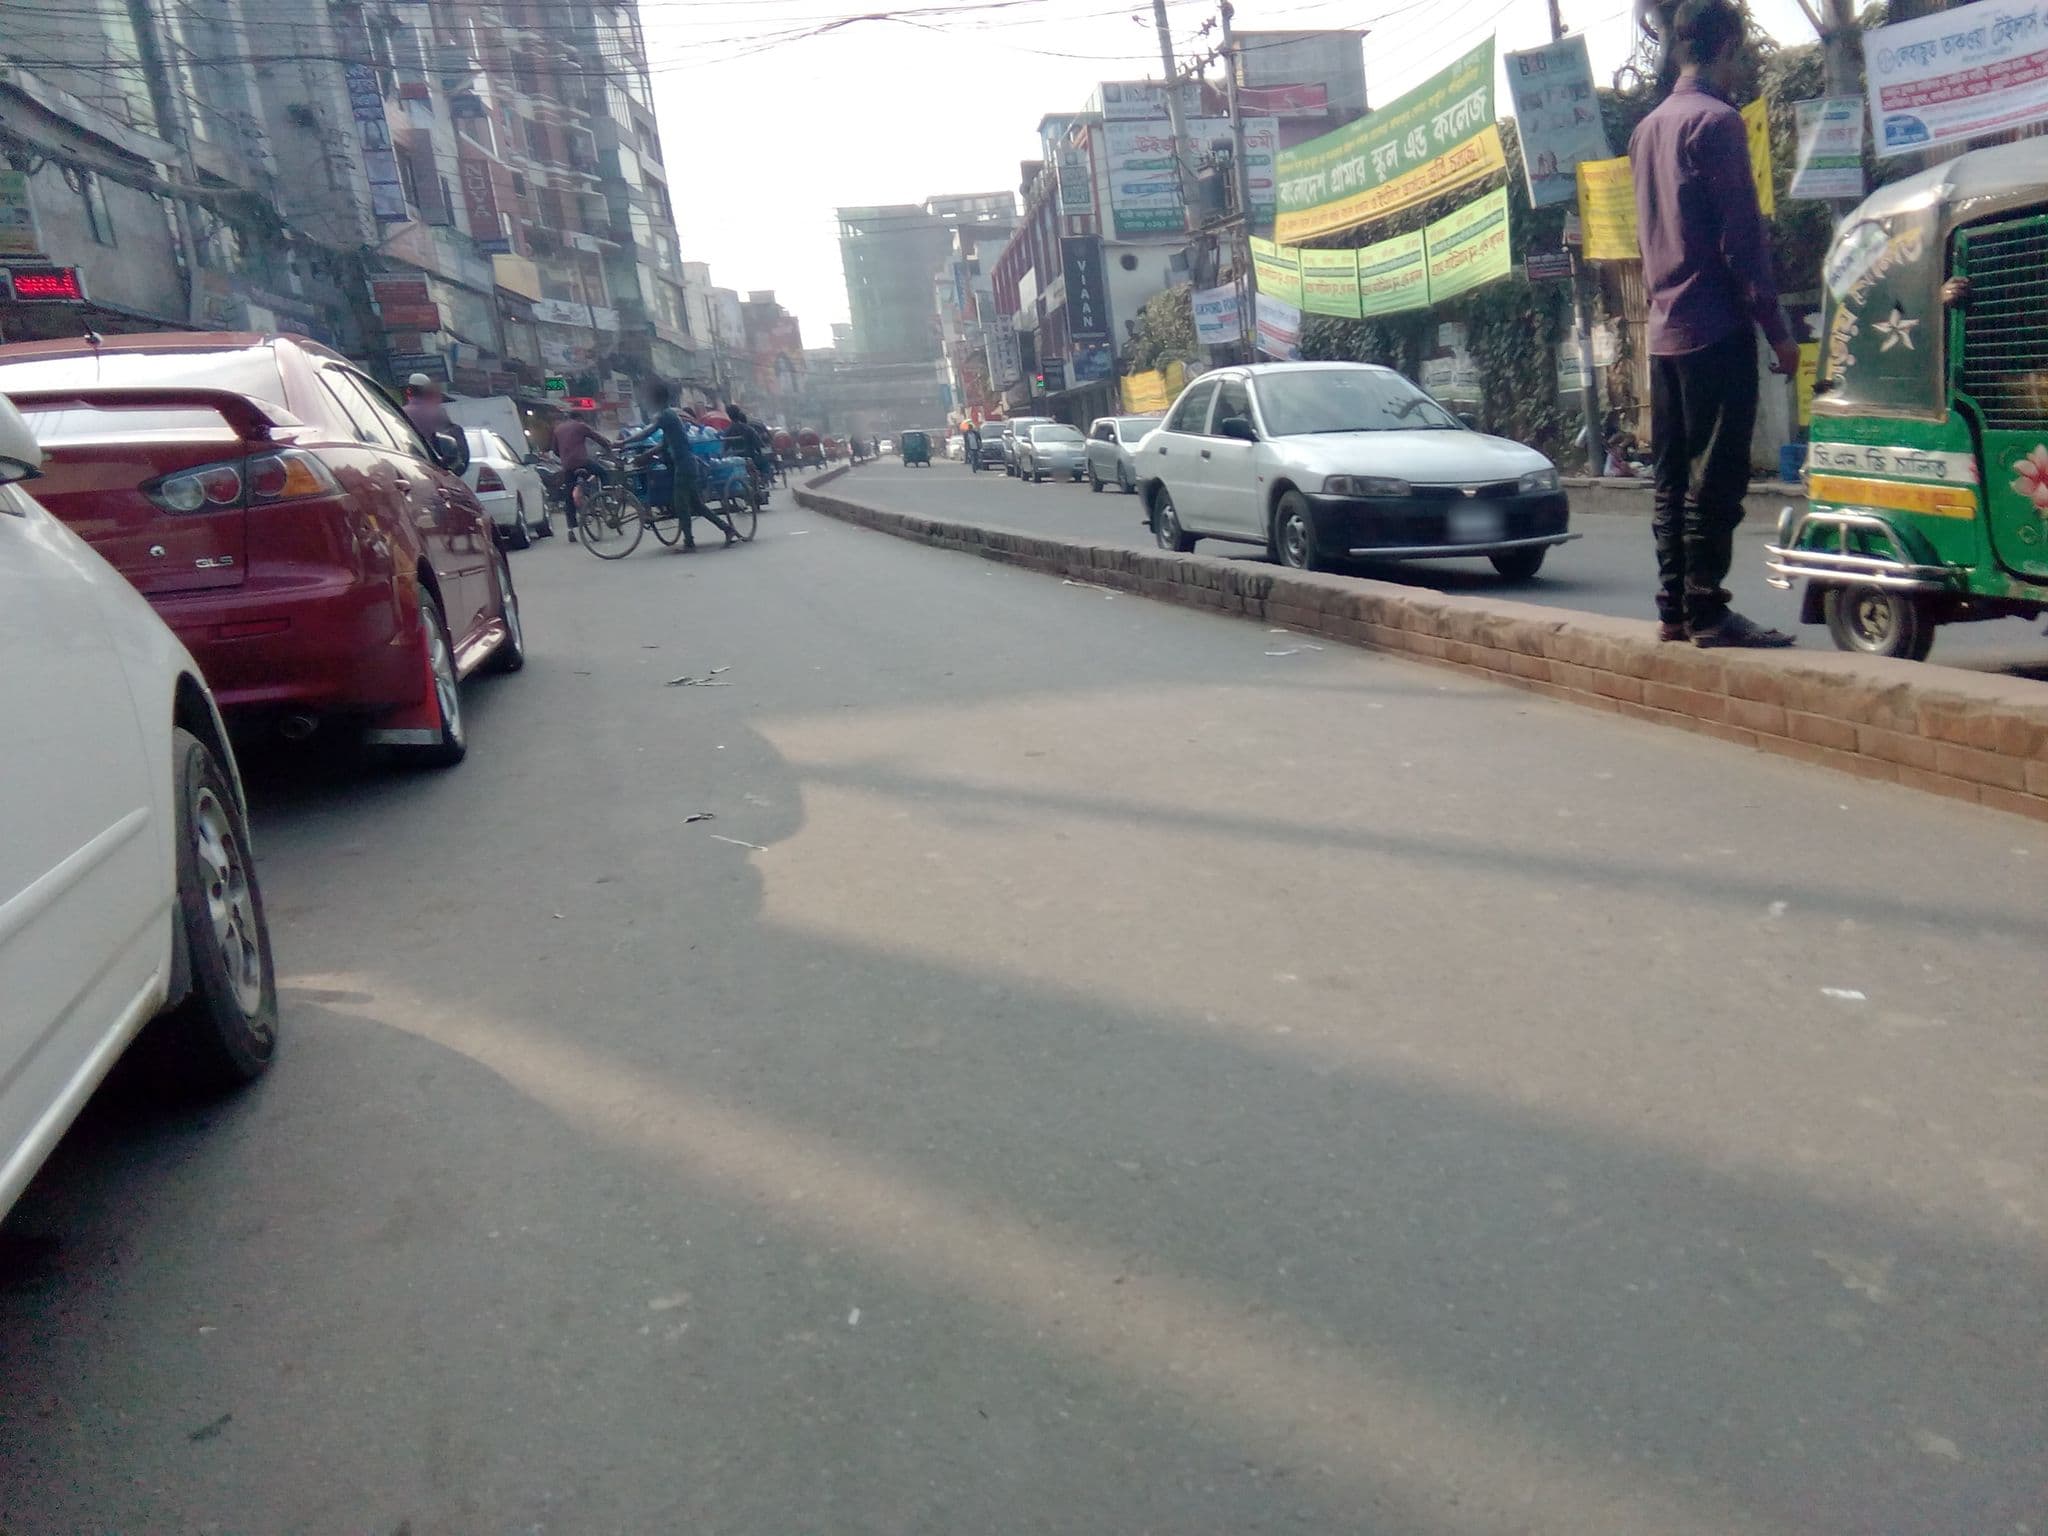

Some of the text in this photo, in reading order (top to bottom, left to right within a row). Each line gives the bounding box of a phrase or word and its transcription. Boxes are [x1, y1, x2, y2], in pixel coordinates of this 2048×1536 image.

[1279, 169, 1328, 206] বাংলাদেশ
[1370, 139, 1400, 182] স্কুল
[1431, 85, 1488, 144] কলেজ
[1077, 260, 1094, 327] VIAAN
[195, 555, 234, 568] GLS
